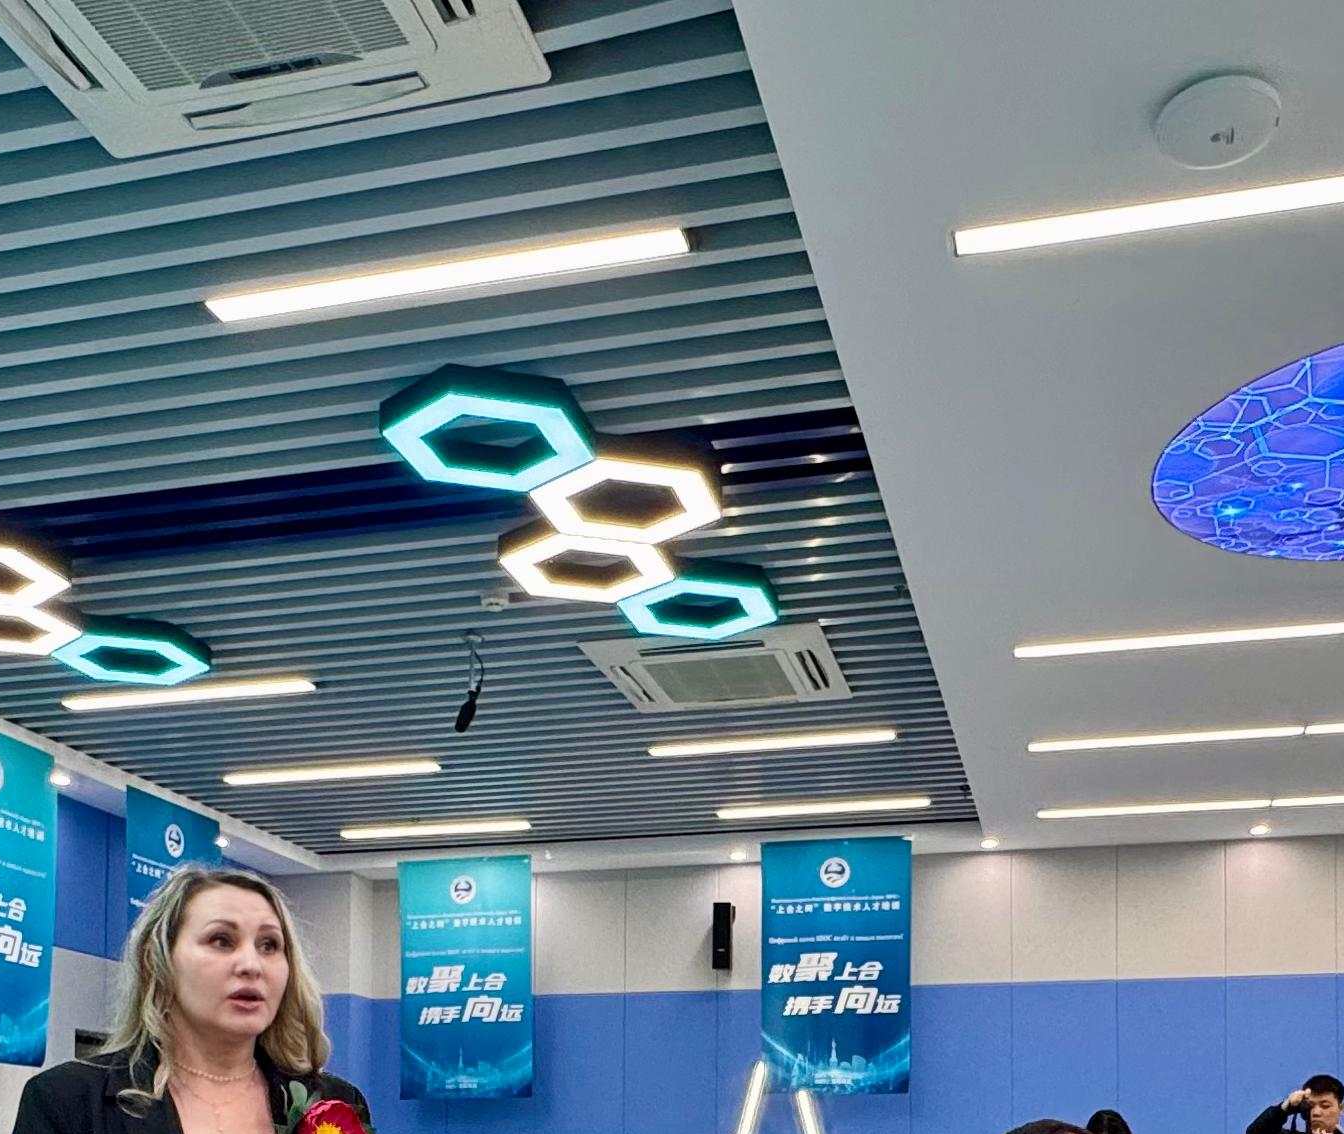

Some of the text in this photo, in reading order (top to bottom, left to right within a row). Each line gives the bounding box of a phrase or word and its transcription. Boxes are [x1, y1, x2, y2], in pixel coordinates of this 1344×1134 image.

[405, 964, 507, 995] 数聚上合
[767, 952, 884, 984] 数聚上合
[782, 985, 902, 1017] 携手向远
